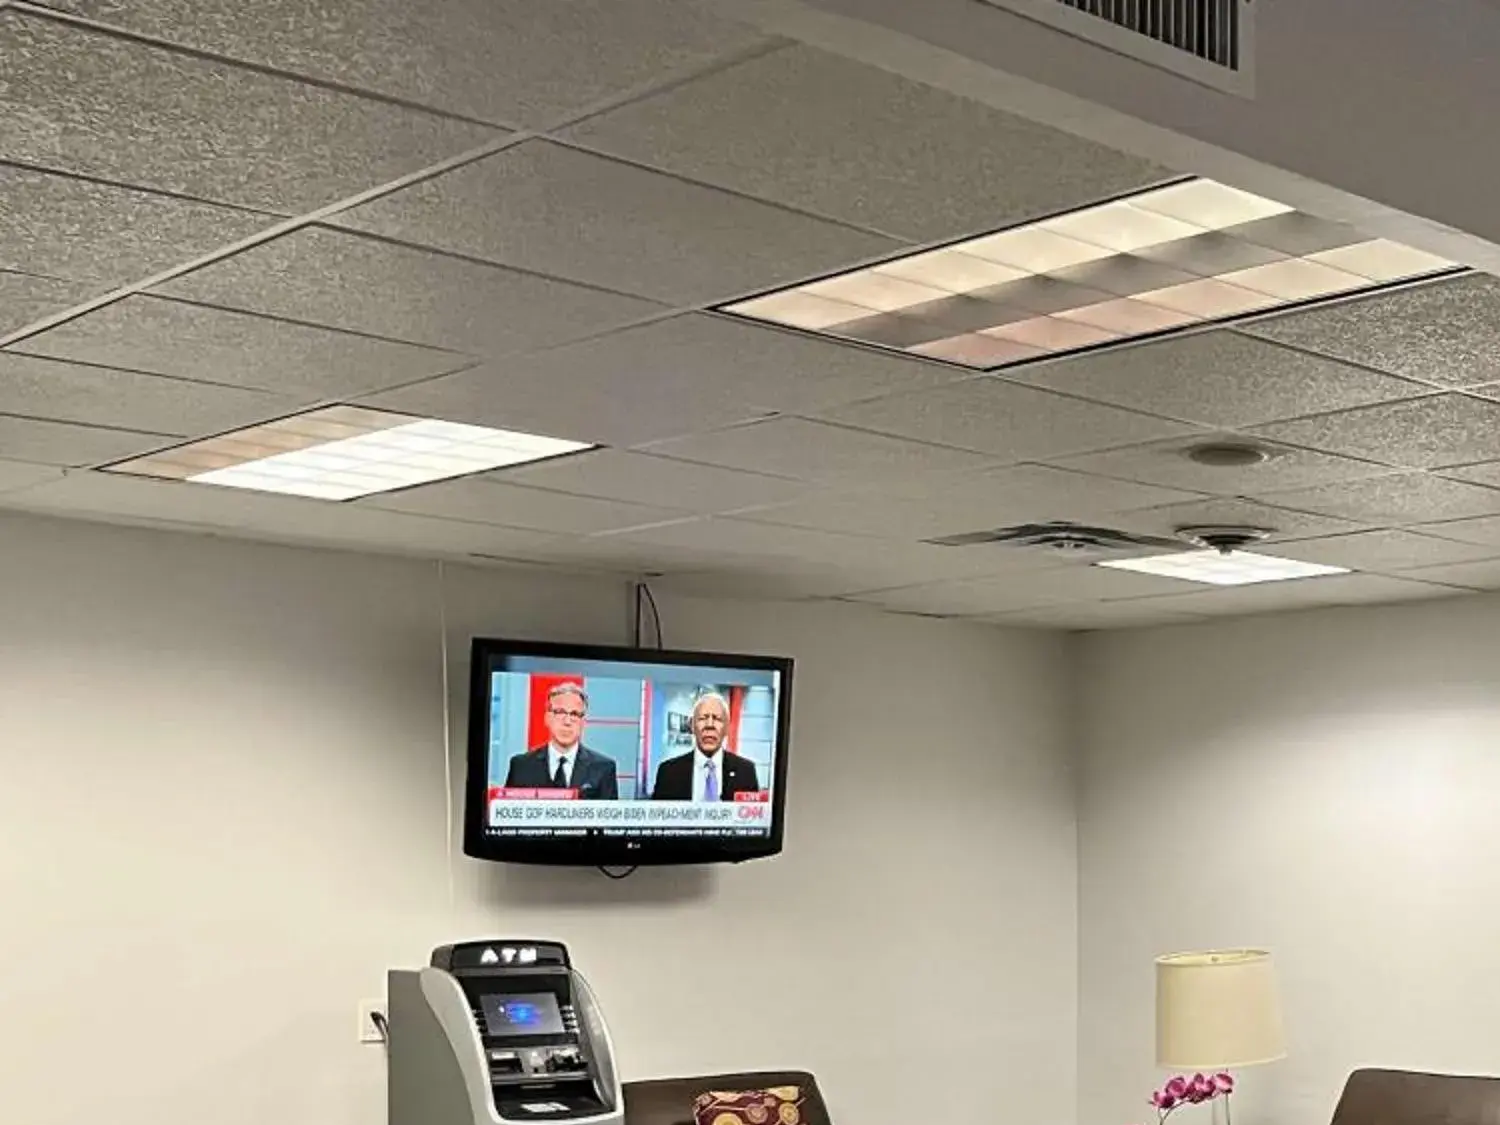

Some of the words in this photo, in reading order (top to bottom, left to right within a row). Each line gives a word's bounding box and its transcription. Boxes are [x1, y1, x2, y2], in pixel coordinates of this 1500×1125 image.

[495, 806, 523, 819] HOUSE
[526, 807, 543, 819] GOP
[545, 807, 594, 820] HARDLINERS
[597, 807, 622, 820] WEIGH
[624, 807, 645, 821] BIDEN
[648, 808, 702, 821] IMPEACHMENT
[704, 808, 732, 821] INQUIRY
[738, 805, 764, 819] CNN
[480, 946, 537, 963] ATM
